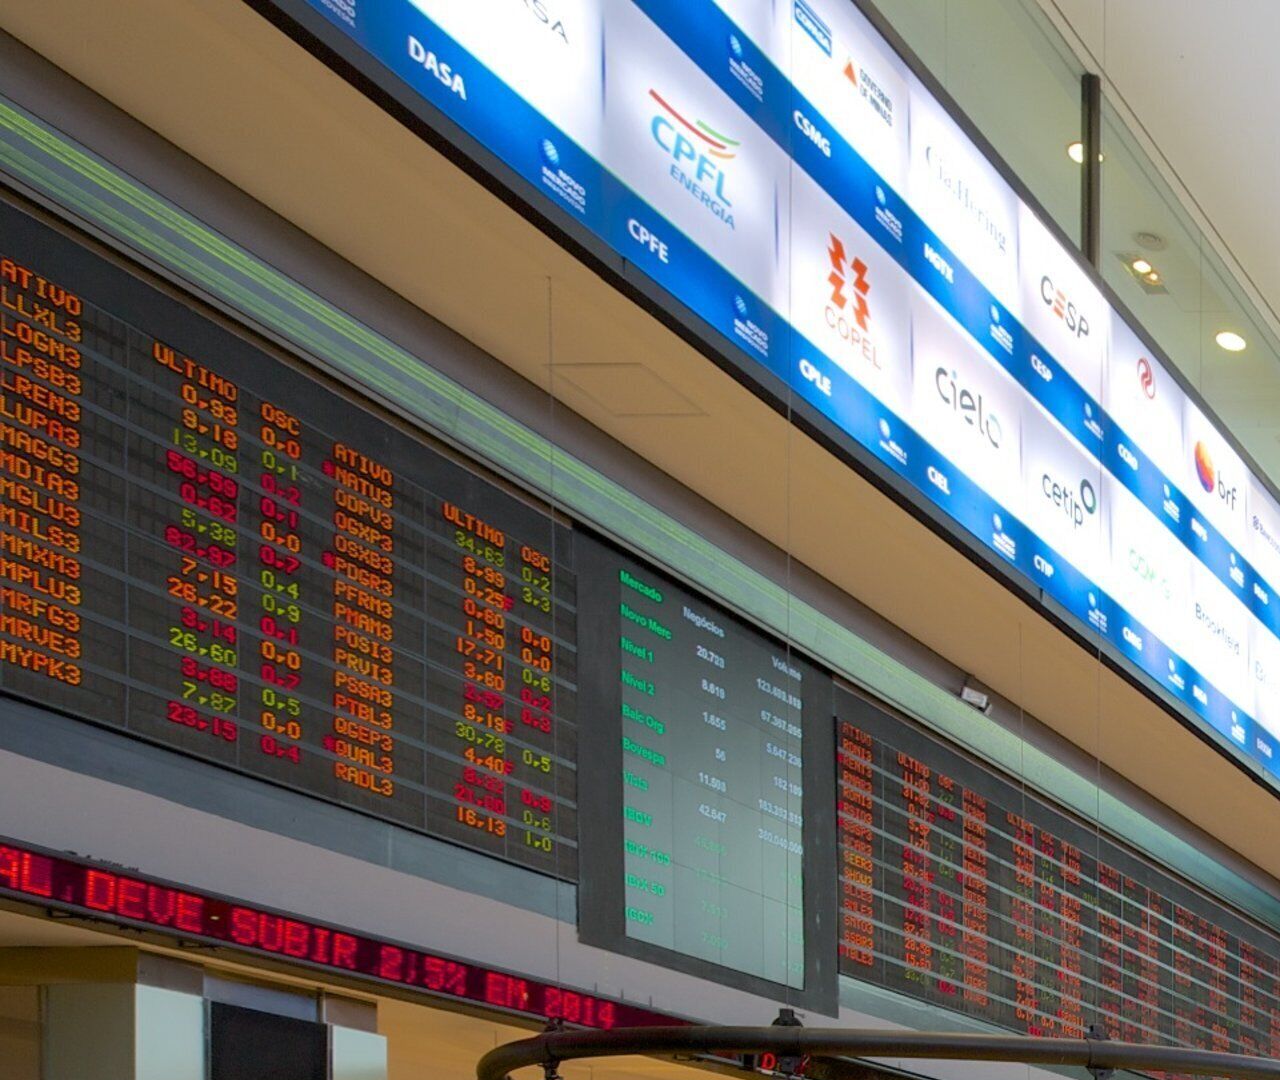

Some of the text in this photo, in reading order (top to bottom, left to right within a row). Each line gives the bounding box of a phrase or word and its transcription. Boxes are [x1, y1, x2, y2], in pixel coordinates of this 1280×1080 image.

[407, 35, 466, 100] DASA
[793, 110, 831, 158] CSMG
[651, 115, 732, 208] CPFL
[670, 165, 736, 231] ENERGIA
[628, 218, 669, 264] CPFE
[2, 285, 81, 343] LLXL3
[1041, 275, 1089, 338] CESP
[1, 313, 81, 369] LOGN3
[1, 259, 300, 436] ATIVO ULTIMO OSC
[825, 306, 882, 370] COPEL
[1, 341, 81, 395] LPSB3
[800, 359, 831, 396] CPLE
[1, 371, 80, 422] LREN3
[0, 396, 80, 449] LUPA3
[0, 423, 79, 474] MAGG3
[334, 443, 393, 486] ATIVO
[0, 452, 79, 500] MDIA3
[1218, 471, 1237, 510] brf
[0, 477, 80, 527] MGLU3
[0, 505, 80, 553] MILS3
[334, 511, 393, 552] OGXP3
[0, 530, 80, 580] MMXM3
[334, 556, 393, 597] PDGR3
[1034, 555, 1054, 577] CTIP
[0, 557, 80, 605] MPLU3
[619, 569, 662, 602] Mercado
[0, 587, 80, 632] MRFG3
[620, 603, 672, 640] Novo Merc
[0, 615, 80, 658] MRVE3
[334, 625, 393, 664] POSI3
[1, 641, 81, 685] MYPK3
[334, 671, 393, 708] PSSA3
[334, 694, 393, 729] PTBL3
[647, 681, 655, 696] 2
[335, 740, 393, 773] QUAL3
[623, 737, 665, 766] Bovespa
[85, 869, 204, 934] DEVE
[230, 907, 357, 967] SUBIR
[485, 969, 528, 1010] EM
[544, 986, 615, 1030] 2014
